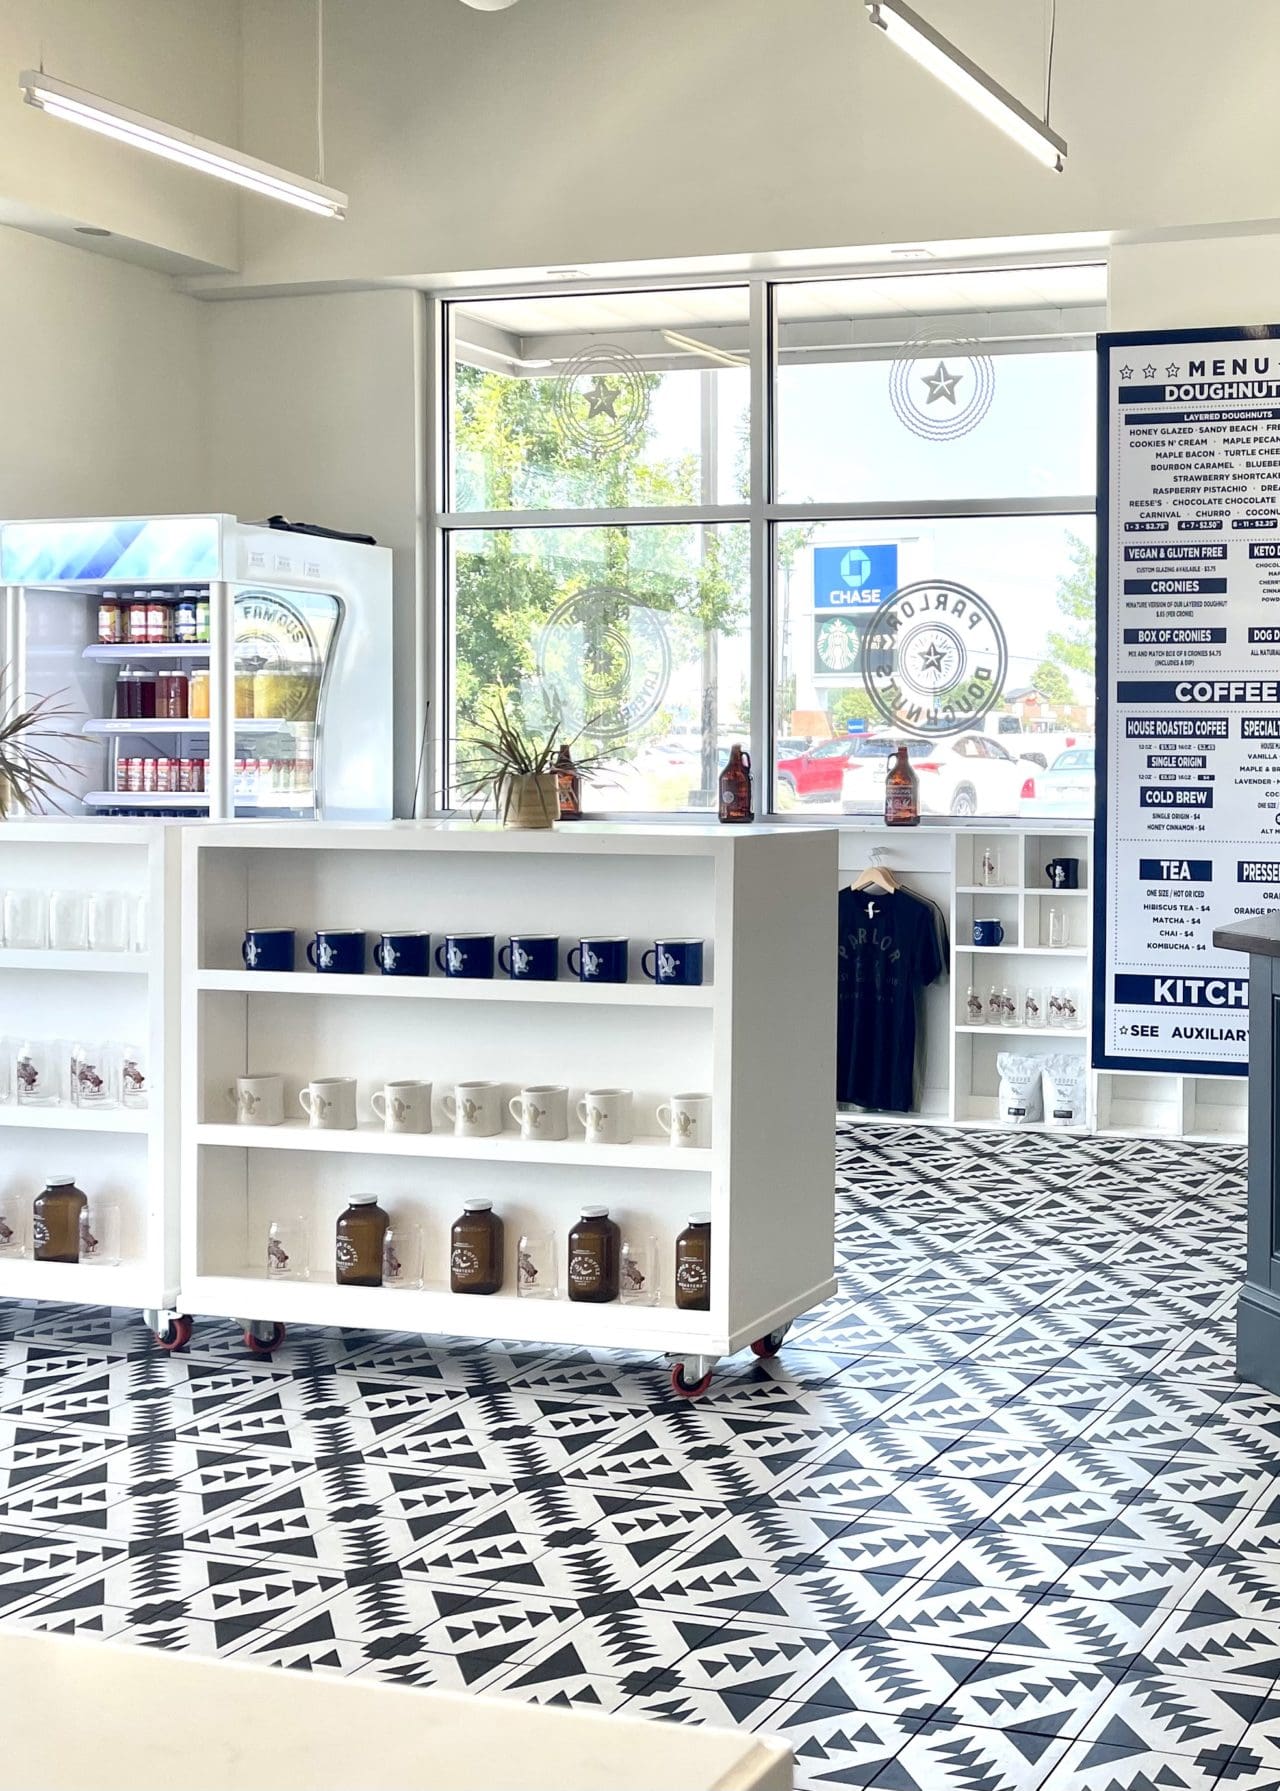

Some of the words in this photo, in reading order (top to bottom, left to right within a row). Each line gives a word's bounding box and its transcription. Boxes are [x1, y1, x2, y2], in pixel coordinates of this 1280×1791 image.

[1189, 358, 1269, 377] MENU
[1184, 413, 1220, 421] LAYERED
[1222, 411, 1273, 420] DOUGHNUTS
[1129, 428, 1158, 436] HONEY
[1160, 427, 1194, 435] GLAZED
[1199, 425, 1227, 434] SANDY
[1229, 424, 1258, 432] BEACH
[1129, 440, 1166, 448] COOKIES
[1178, 438, 1208, 446] CREAM
[1222, 437, 1251, 445] MAPLE
[1155, 451, 1184, 459] MAPLE
[1185, 450, 1215, 458] BACON
[1224, 448, 1257, 456] TURTLE
[1150, 463, 1192, 471] BOURBON
[1193, 461, 1234, 470] CARAMEL
[1173, 473, 1230, 482] STRAWBERRY
[1152, 486, 1202, 495] RASPBERRY
[1203, 485, 1248, 493] PISTACHIO
[1129, 499, 1162, 507] REESE'S
[1172, 498, 1223, 506] CHOCOLATE
[1225, 496, 1277, 504] CHOCOLATE
[1139, 511, 1181, 519] CARNIVAL
[1195, 509, 1231, 517] CHURRO
[1128, 548, 1157, 559] VEGAN
[1159, 548, 1165, 558] &
[1167, 547, 1200, 558] GLUTEN
[1201, 546, 1223, 557] FREE
[1254, 545, 1276, 557] KETO
[1150, 580, 1200, 592] CRONIES
[829, 588, 881, 605] CHASE
[1138, 630, 1157, 642] BOX
[1159, 630, 1171, 641] OF
[1172, 629, 1212, 641] CRONIES
[1254, 629, 1272, 640] DOG
[1175, 682, 1278, 702] COFFEE
[1127, 720, 1155, 735] HOUSE
[1156, 720, 1194, 735] ROASTED
[1195, 720, 1227, 735] COFFEE
[1151, 756, 1177, 767] SINGLE
[1177, 756, 1203, 767] ORIGIN
[1145, 790, 1174, 803] COLD
[1176, 791, 1207, 804] BREW
[1160, 860, 1191, 880] TEA
[1146, 889, 1157, 897] ONE
[1158, 889, 1169, 897] SIZE
[1184, 890, 1192, 898] OR
[1192, 890, 1205, 898] ICED
[1234, 907, 1266, 915] ORANGE
[838, 927, 901, 963] PARLOR
[1146, 942, 1190, 950] KOMBUCHA
[1154, 978, 1249, 1006] KITCH
[1130, 1024, 1159, 1037] SEE
[1171, 1026, 1250, 1041] AUXILIAR
